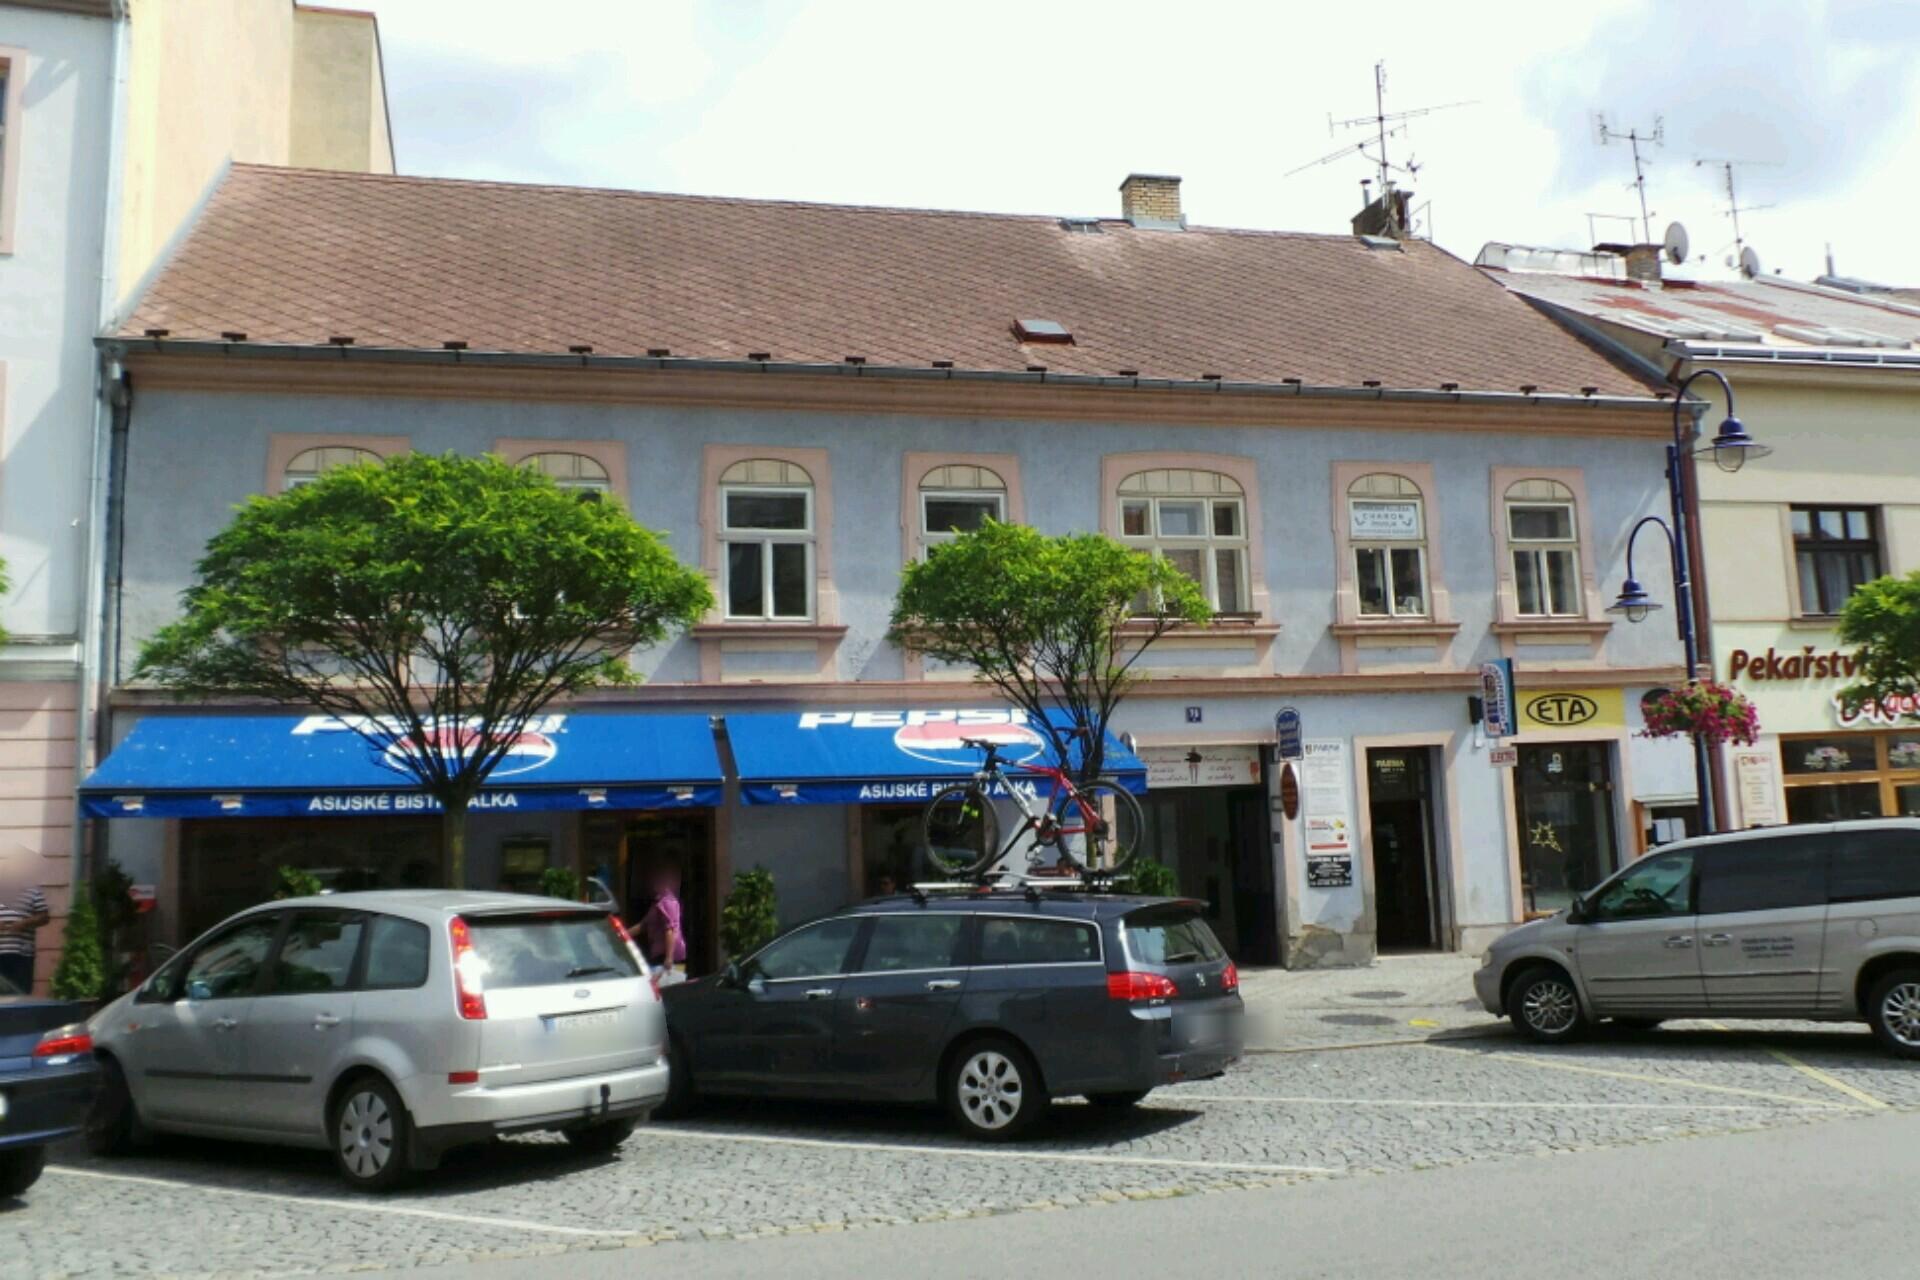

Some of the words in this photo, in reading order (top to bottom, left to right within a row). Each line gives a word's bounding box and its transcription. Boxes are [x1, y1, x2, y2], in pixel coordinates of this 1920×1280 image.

[798, 708, 1028, 728] PEPSI
[1536, 698, 1587, 721] ETA
[859, 782, 928, 799] ASIJSKÉ
[308, 792, 390, 811] ASIJSKÉ
[394, 794, 442, 810] BIST
